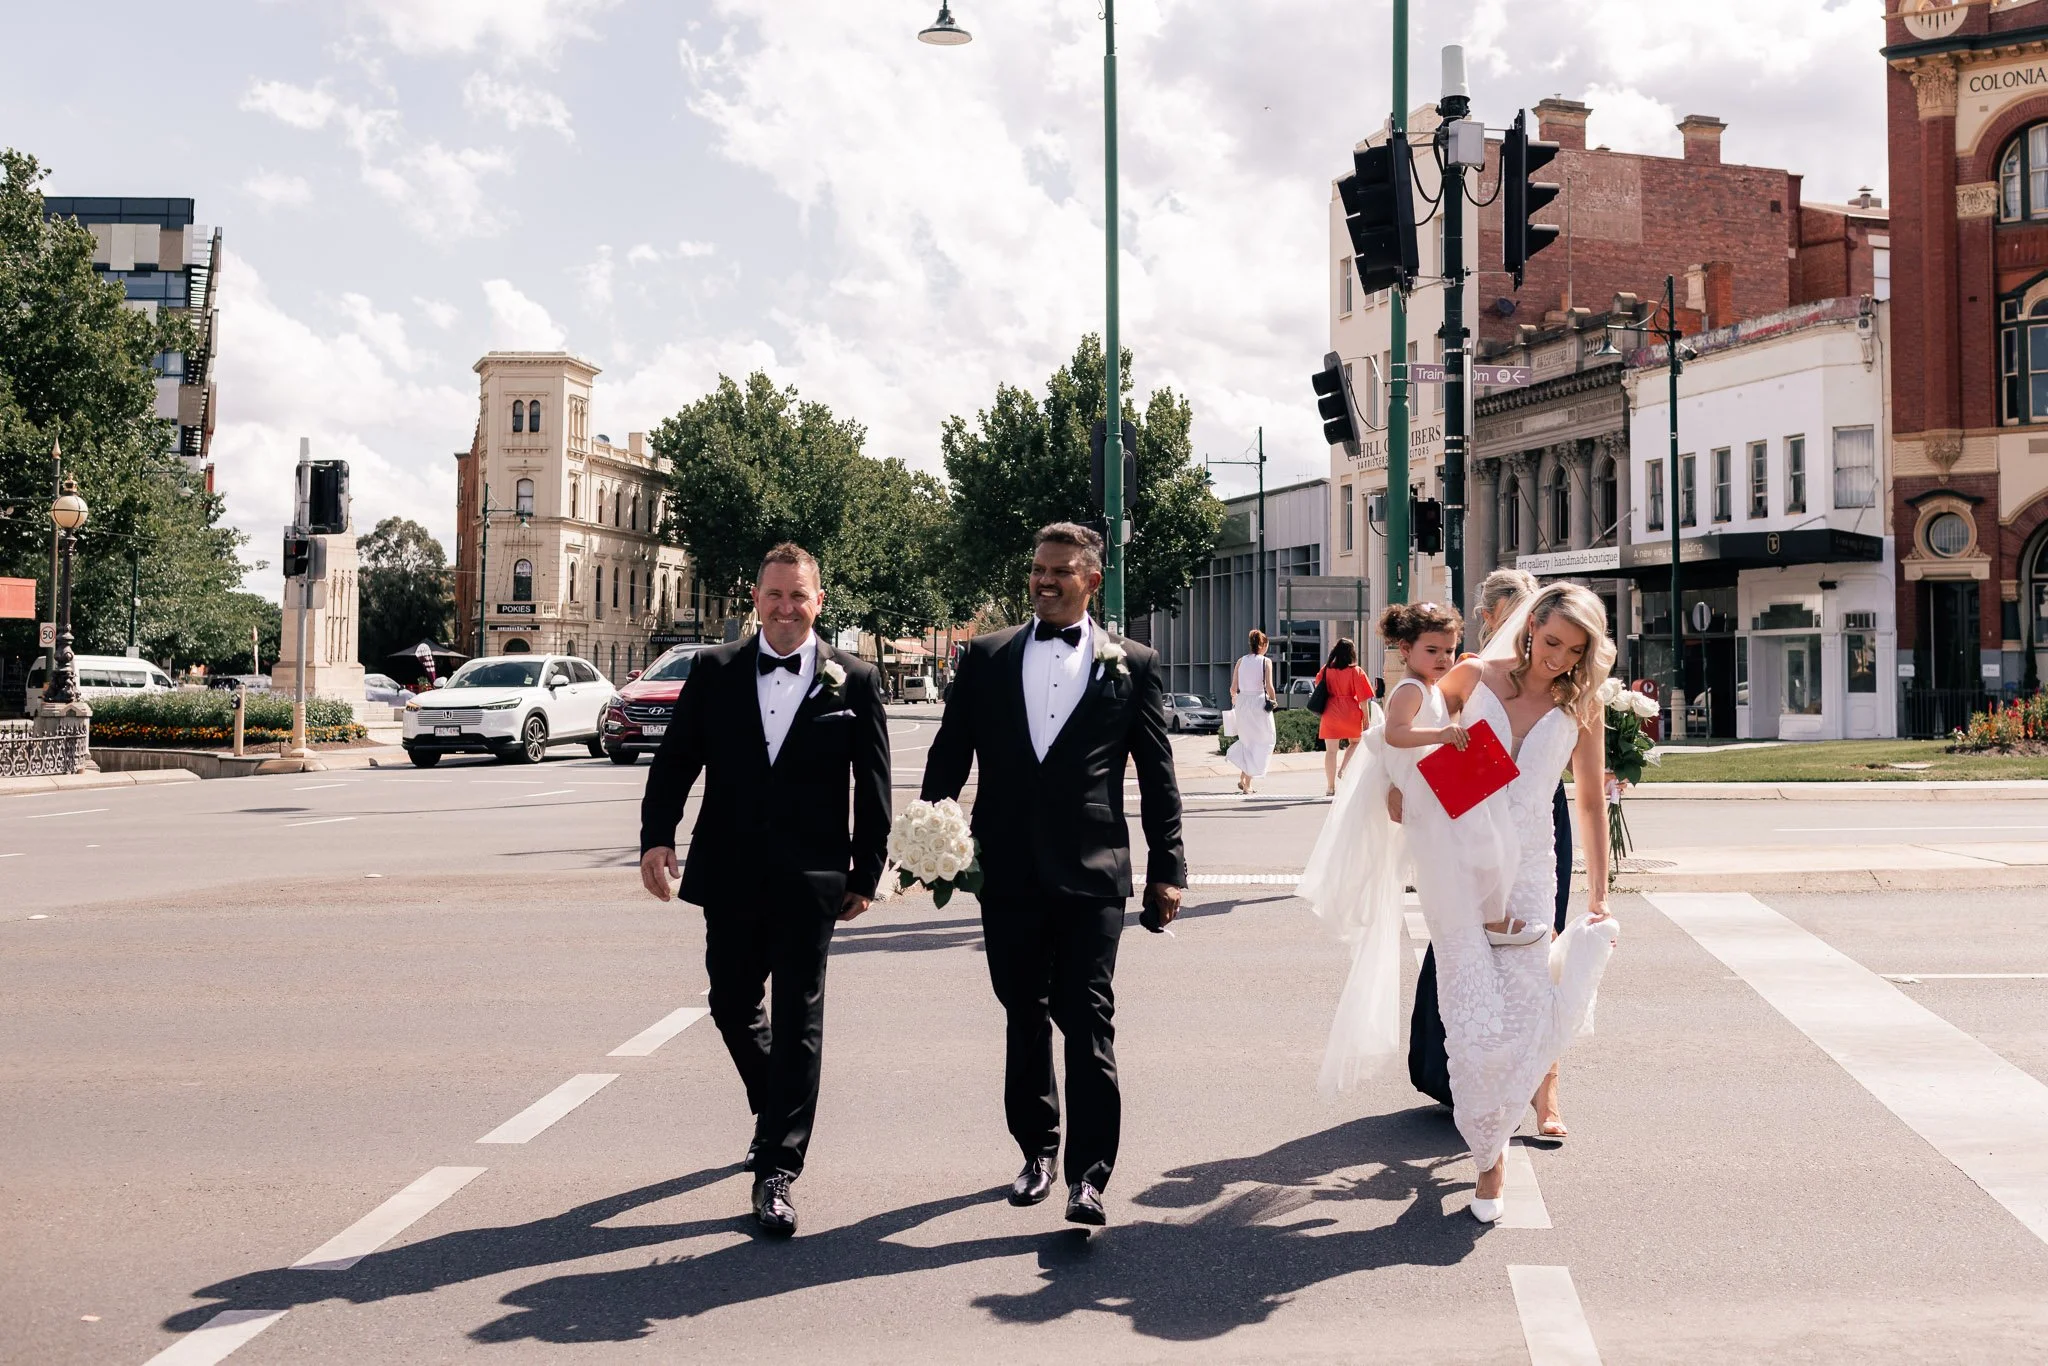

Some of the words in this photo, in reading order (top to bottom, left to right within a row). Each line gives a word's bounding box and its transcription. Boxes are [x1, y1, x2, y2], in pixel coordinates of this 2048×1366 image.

[1969, 67, 2047, 93] COLONIA
[1416, 368, 1445, 380] Train
[1473, 369, 1489, 382] 0m
[1633, 549, 1639, 559] A
[1518, 560, 1527, 570] art
[1527, 558, 1550, 572] gallery
[1553, 553, 1588, 568] handmade
[1588, 551, 1618, 565] boutique
[502, 605, 531, 613] POKIES
[42, 630, 54, 640] 50
